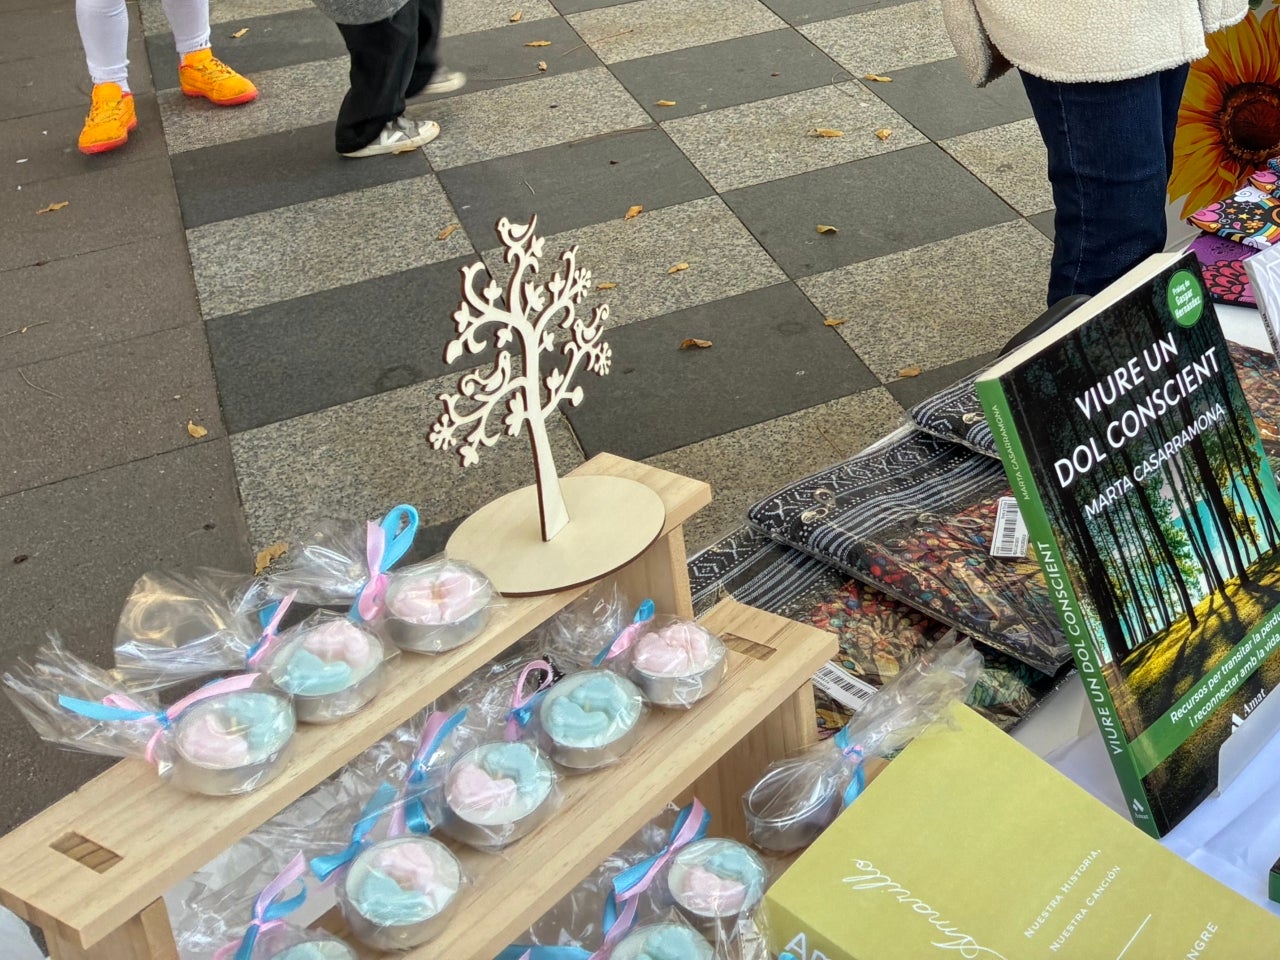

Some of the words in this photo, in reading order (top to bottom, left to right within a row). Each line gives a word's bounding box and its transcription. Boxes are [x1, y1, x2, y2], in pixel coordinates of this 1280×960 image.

[1075, 357, 1145, 420] VIURE
[1144, 331, 1179, 372] UN
[992, 404, 1020, 472] CASARRAMONA
[1053, 436, 1107, 489] DOL
[1106, 346, 1220, 449] CONSCIENT
[1016, 468, 1030, 500] MARTA
[1084, 476, 1134, 520] MARTA
[1133, 402, 1225, 483] CASARRAMONA
[1037, 541, 1080, 636] CONSCIENT
[1074, 639, 1094, 673] DOL
[1087, 678, 1105, 703] UN
[1170, 684, 1208, 724] Recursos
[1207, 672, 1222, 694] per
[1220, 641, 1253, 676] transitar
[1251, 632, 1261, 647] la
[1194, 674, 1240, 723] reconnectar
[1239, 658, 1258, 681] amb
[1257, 649, 1266, 665] la
[1266, 633, 1280, 653] vida
[1098, 706, 1123, 755] VIURE
[1243, 687, 1267, 718] Amat
